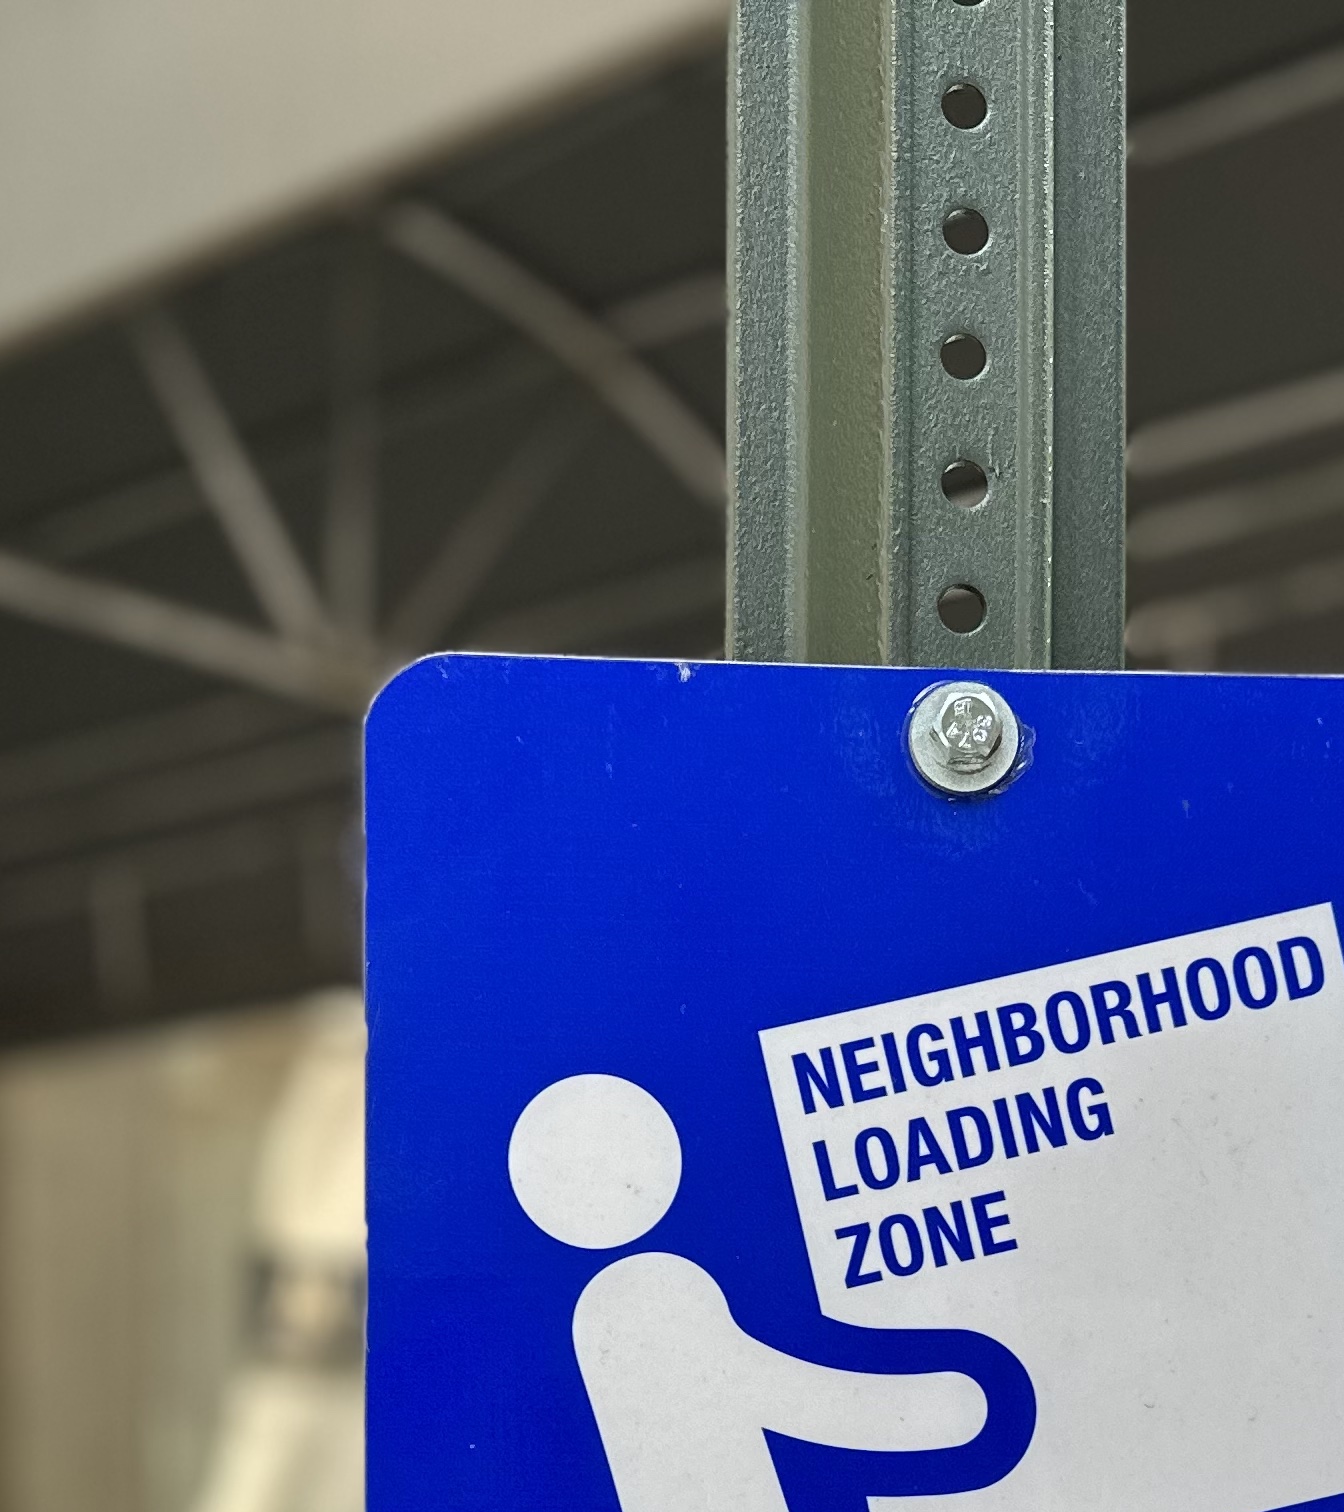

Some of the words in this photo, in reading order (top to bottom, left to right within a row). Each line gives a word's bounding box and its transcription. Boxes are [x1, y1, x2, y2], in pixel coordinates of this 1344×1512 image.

[791, 935, 1325, 1115] NEIGHBORHOOD
[812, 1077, 1115, 1202] LOADING
[834, 1190, 1018, 1290] ZONE
